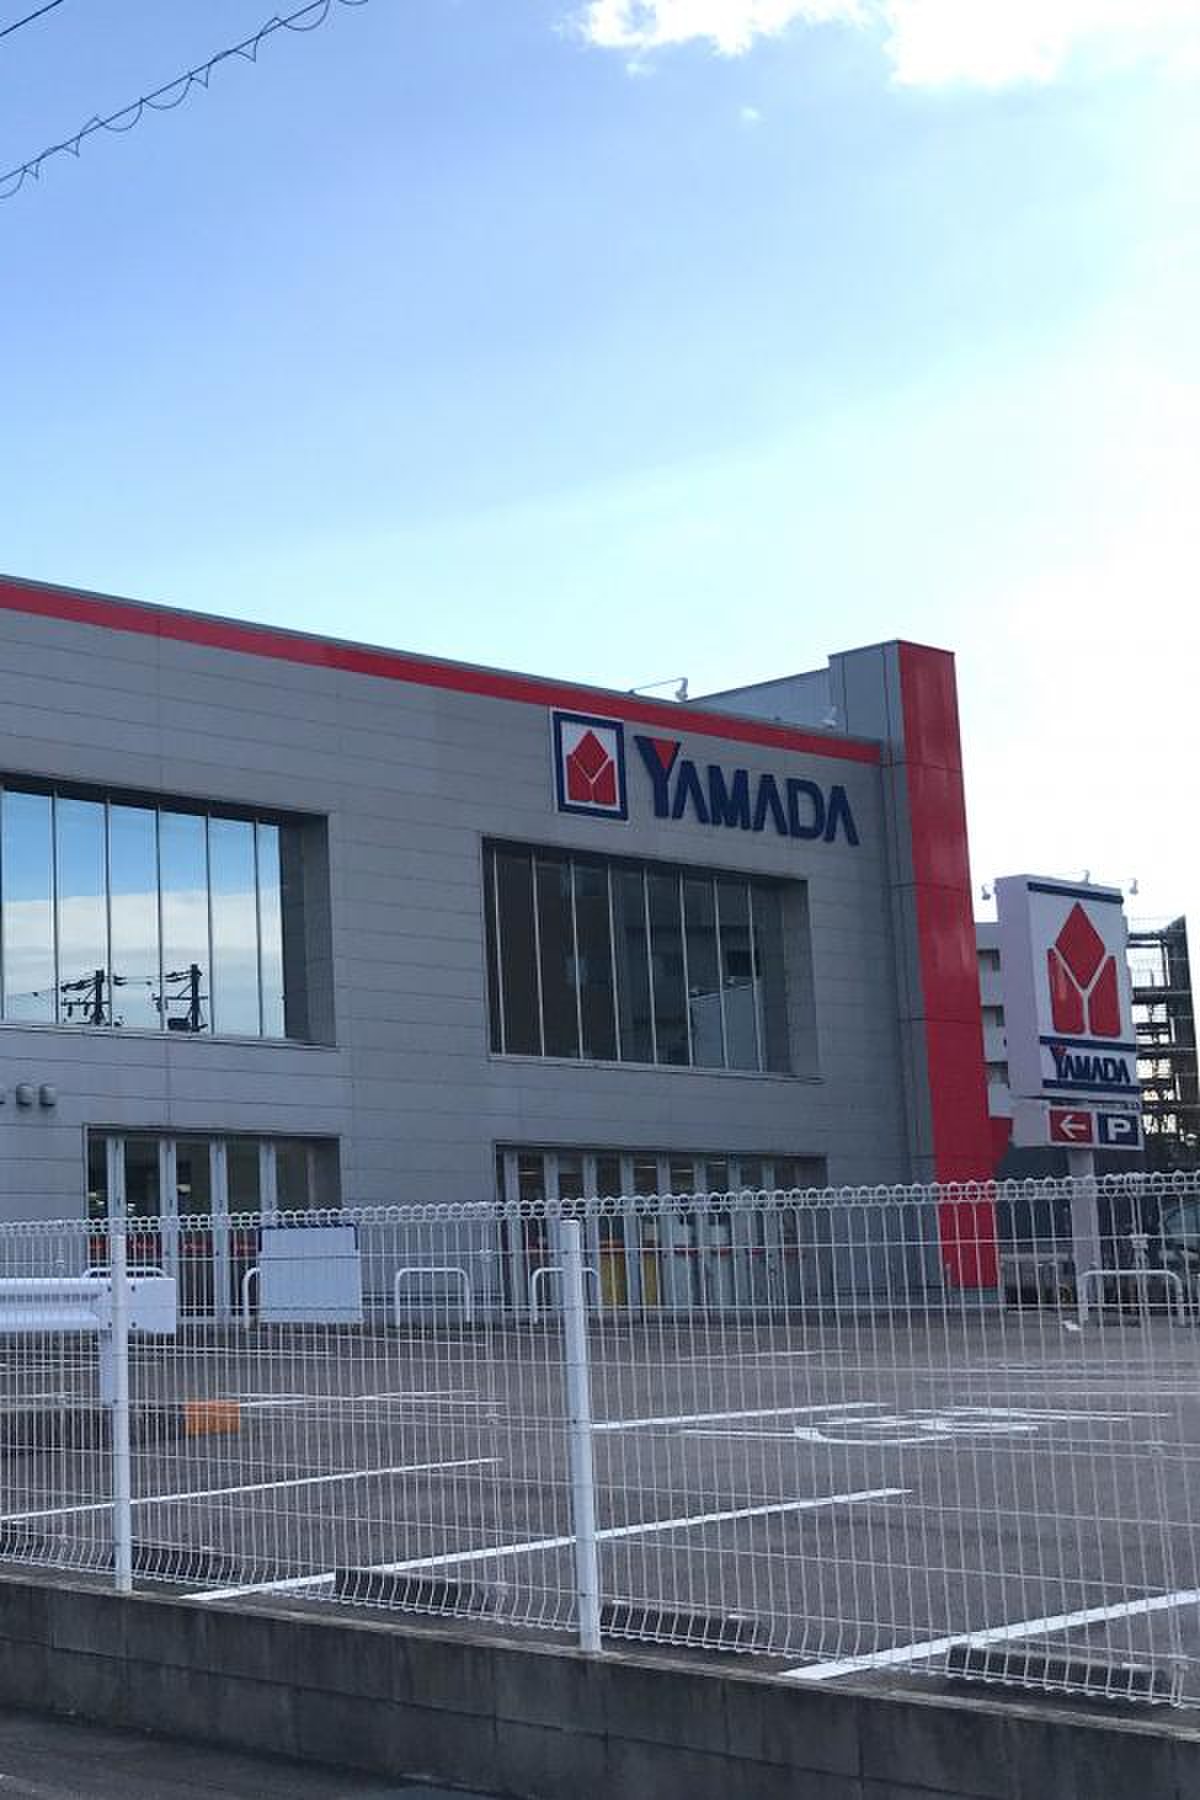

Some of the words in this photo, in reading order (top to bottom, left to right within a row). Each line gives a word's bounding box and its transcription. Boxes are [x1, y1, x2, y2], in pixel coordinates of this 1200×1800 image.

[634, 736, 860, 846] YAMADA
[1050, 1045, 1131, 1084] YAMADA
[1107, 1118, 1132, 1141] P
